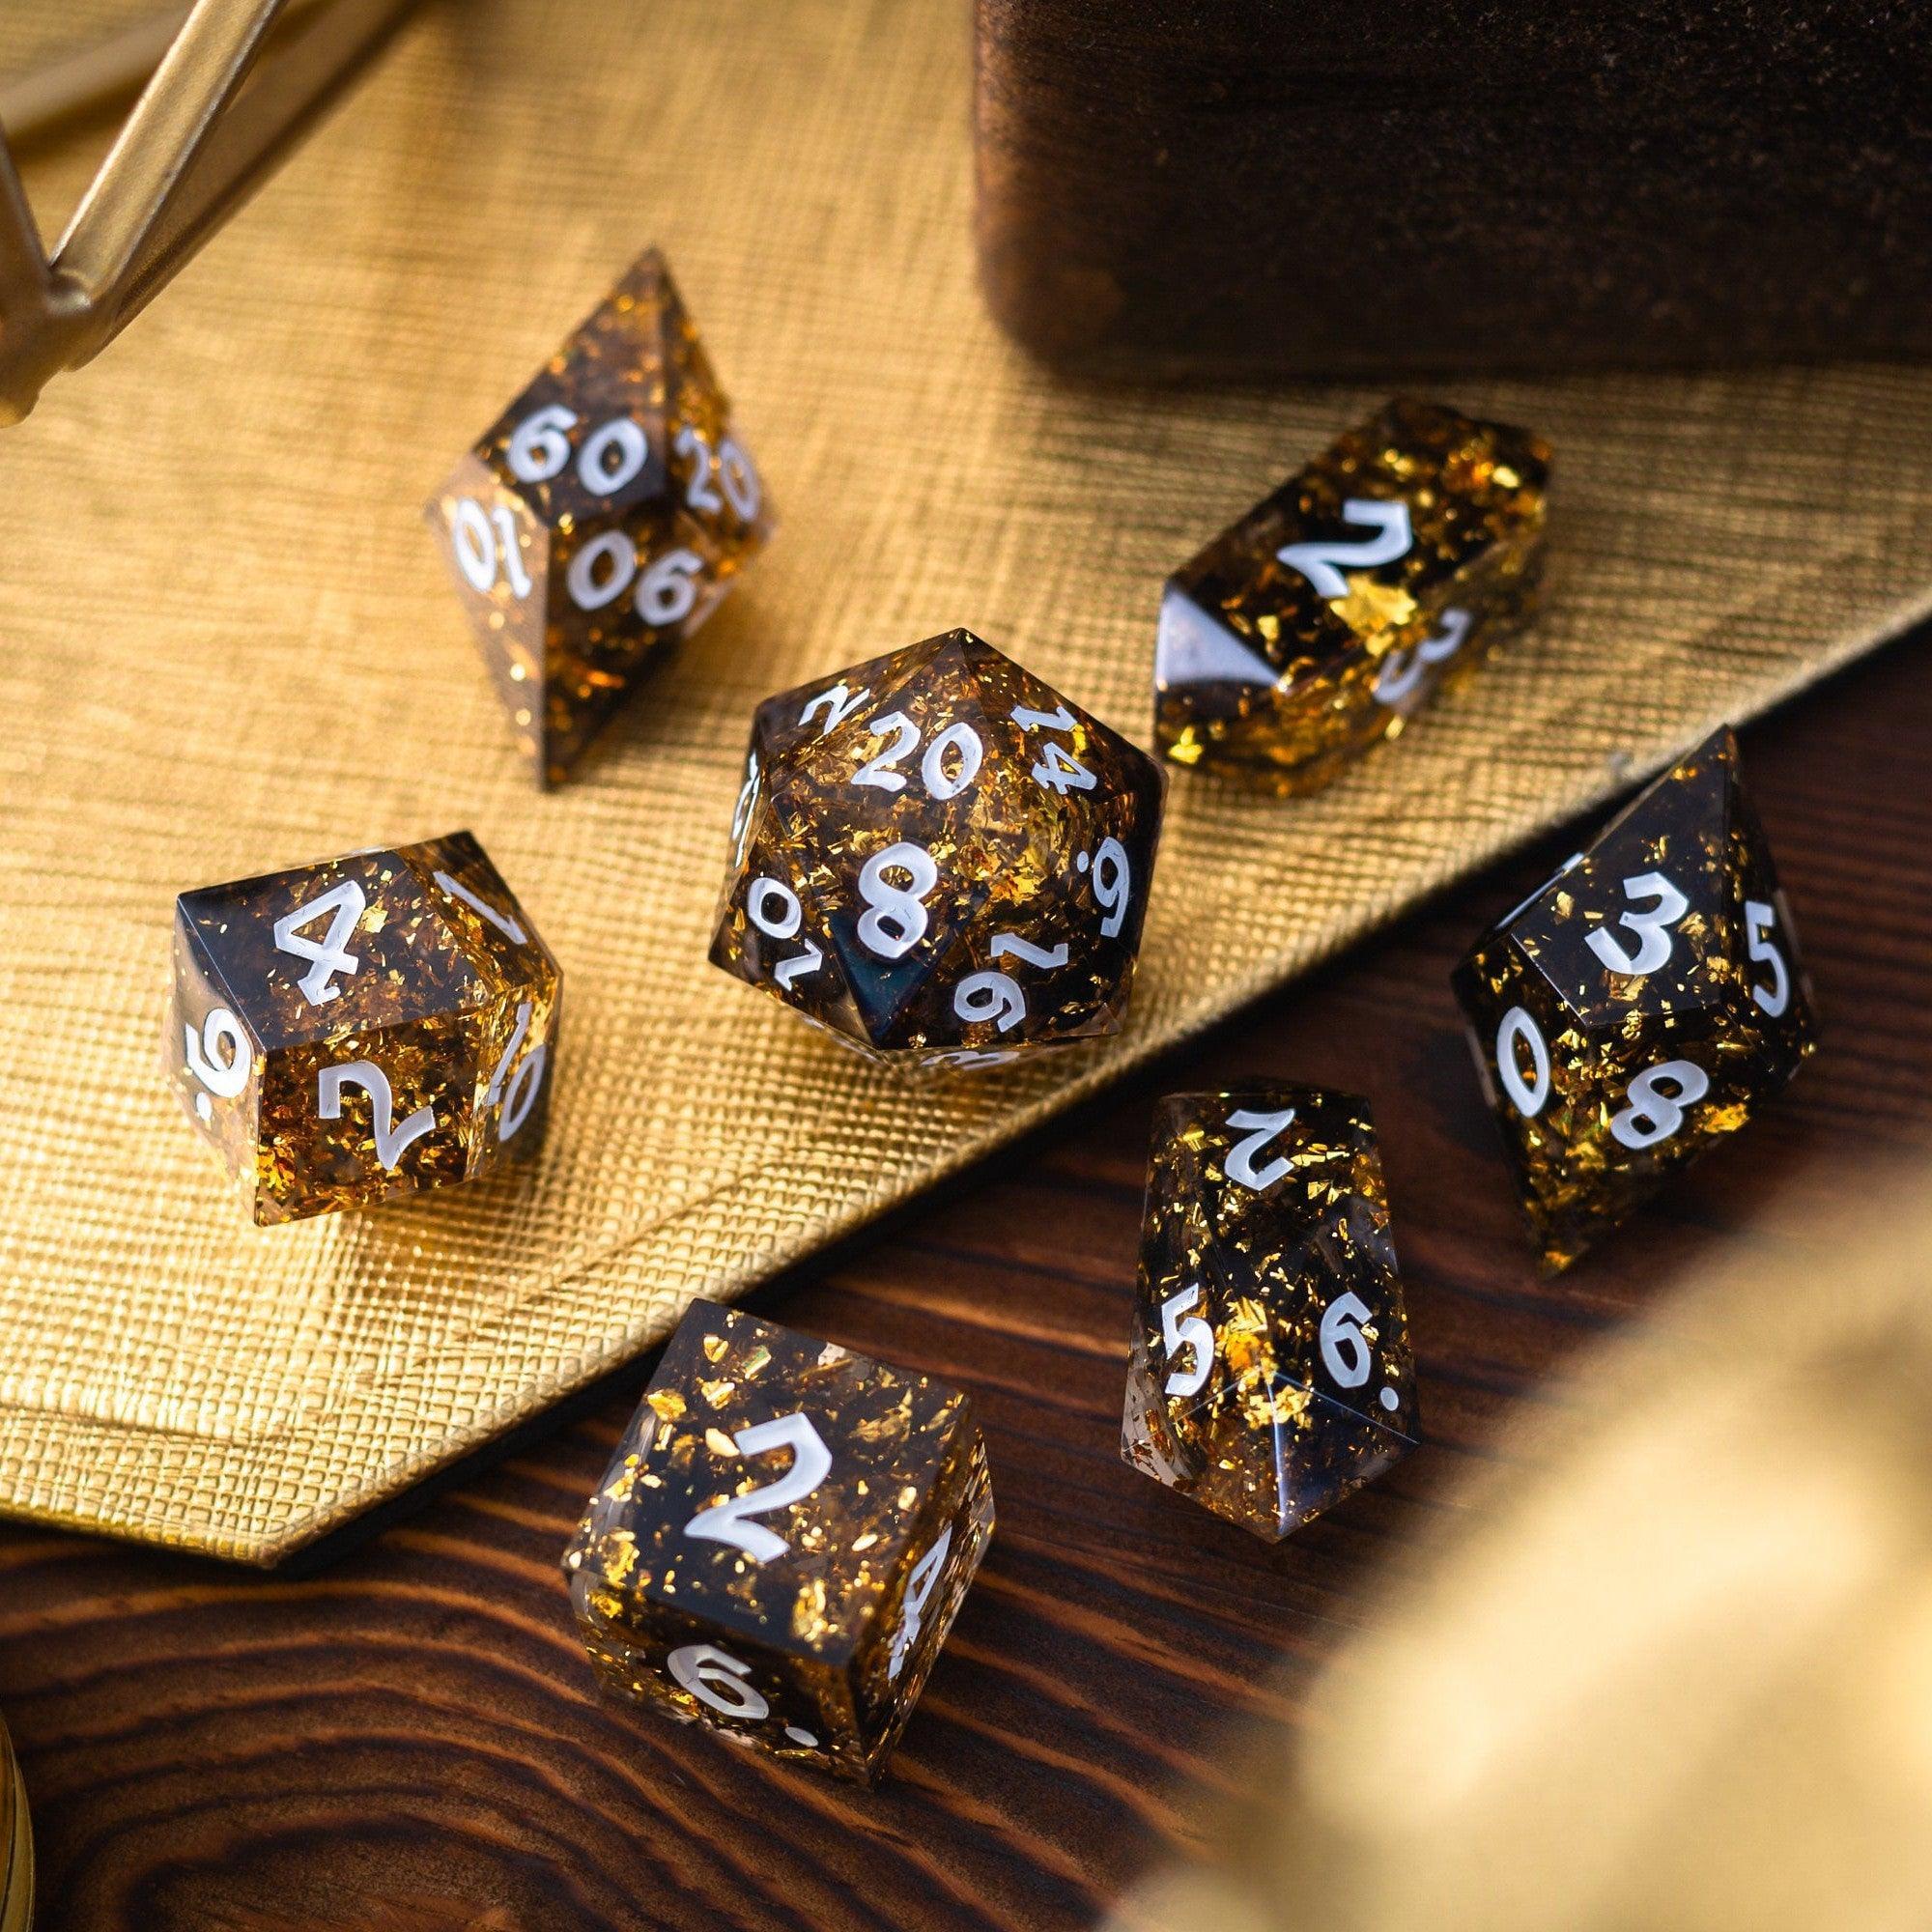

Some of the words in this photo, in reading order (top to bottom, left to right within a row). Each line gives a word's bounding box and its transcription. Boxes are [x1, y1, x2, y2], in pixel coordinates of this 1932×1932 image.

[508, 405, 648, 496] 60
[675, 425, 760, 522] 20
[1277, 498, 1414, 597] 2
[852, 711, 983, 800] 20
[1009, 705, 1097, 795] 14
[273, 879, 366, 1006] 4
[858, 841, 938, 959] 8
[1584, 871, 1690, 976] 3
[1745, 899, 1790, 1018] 5
[319, 1059, 437, 1171] 2
[1496, 1006, 1550, 1118] 0
[1610, 1059, 1709, 1150] 8
[1225, 1108, 1295, 1191] 2
[1161, 1283, 1215, 1397] 5
[684, 1411, 833, 1563] 2
[888, 1520, 952, 1680] 4
